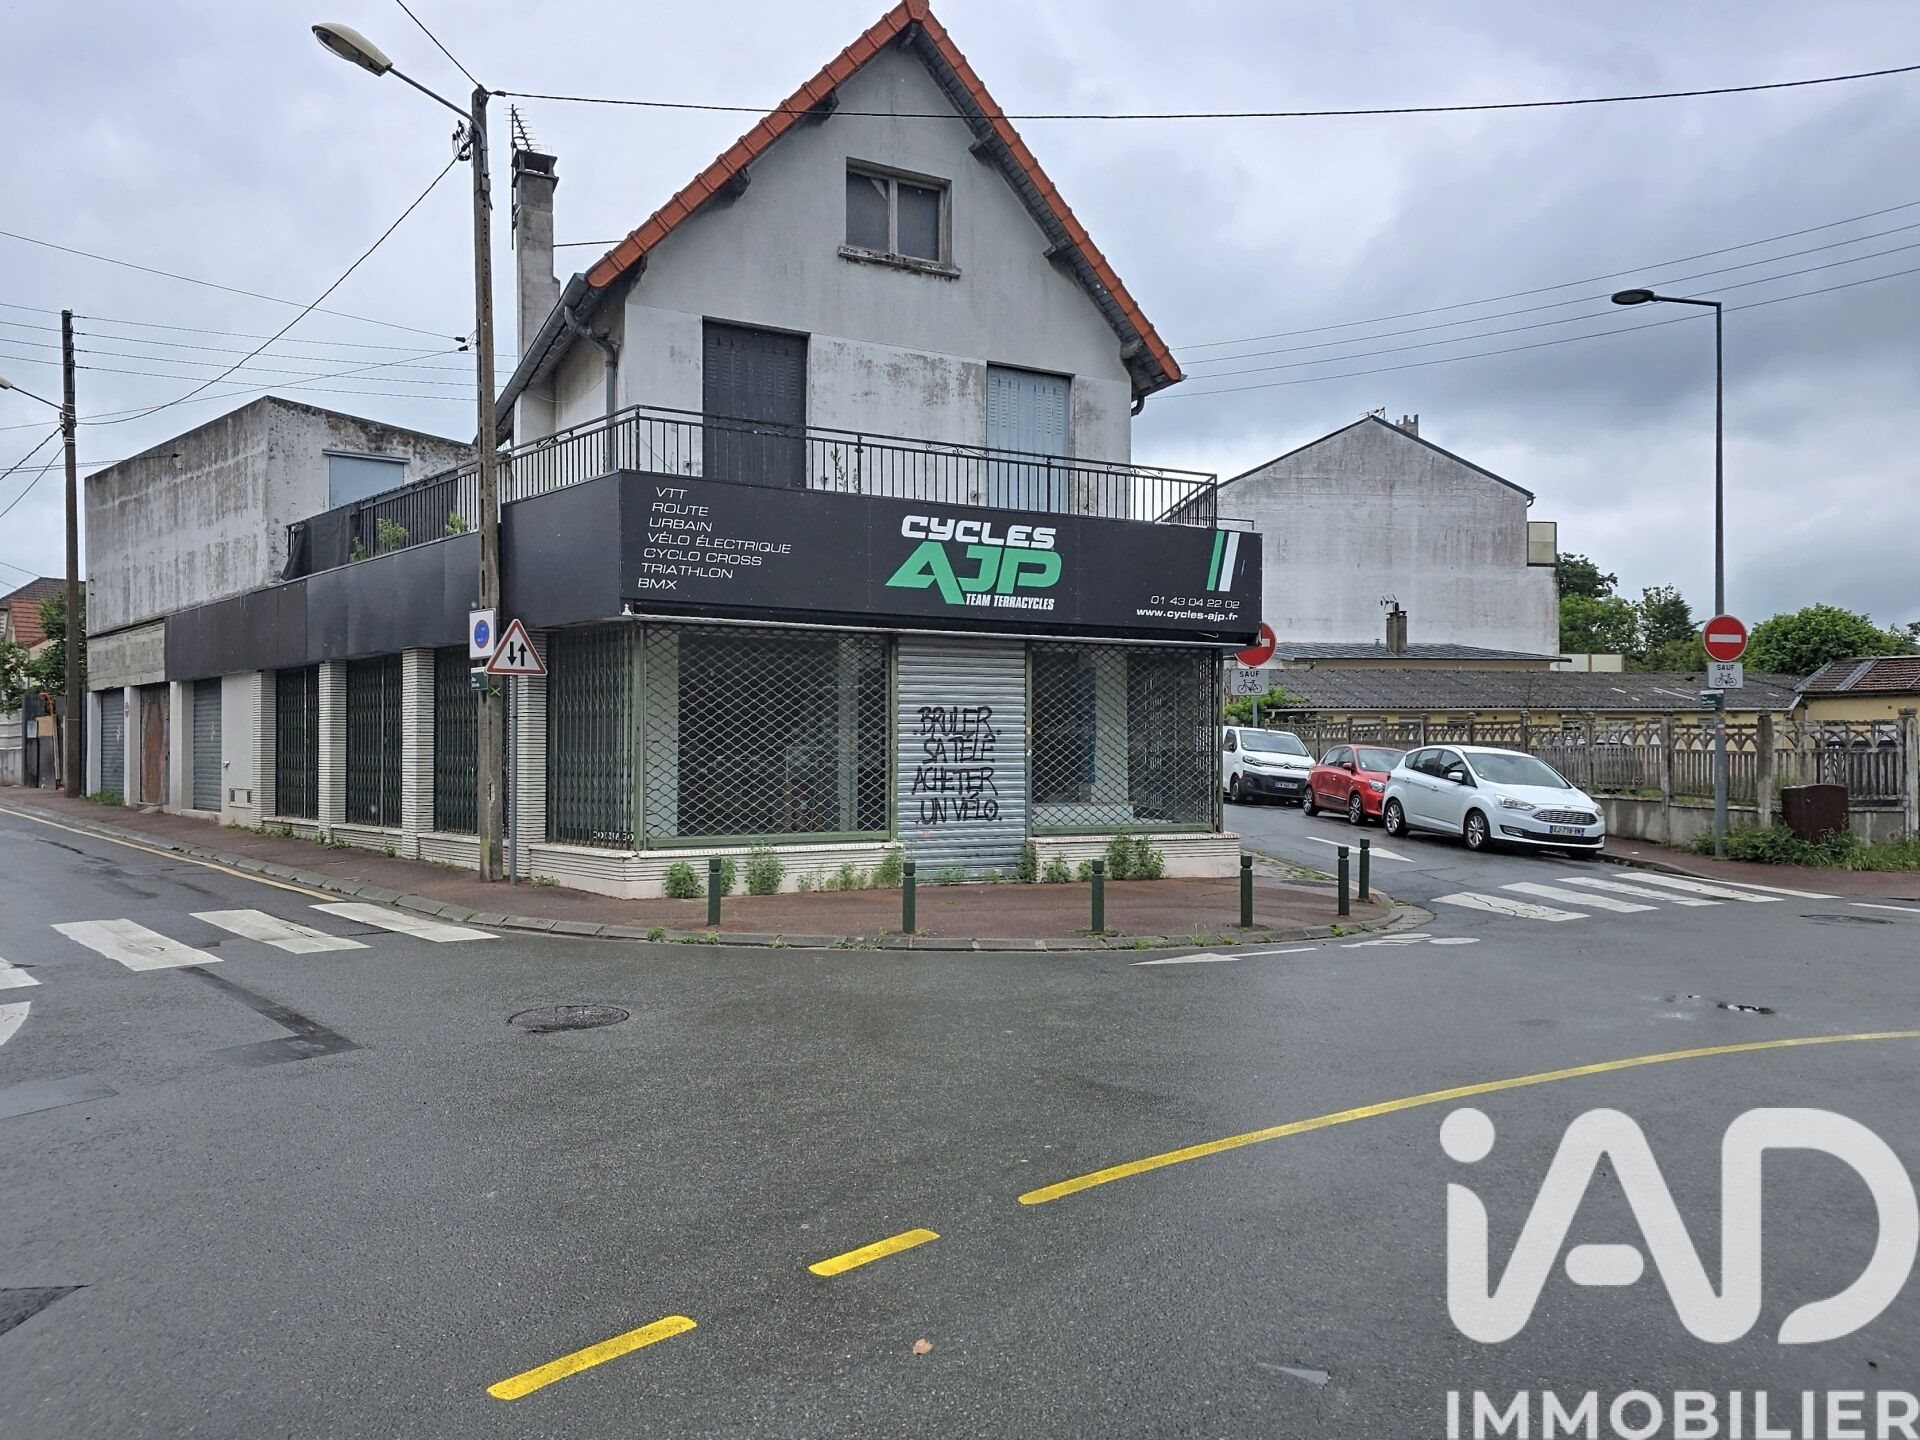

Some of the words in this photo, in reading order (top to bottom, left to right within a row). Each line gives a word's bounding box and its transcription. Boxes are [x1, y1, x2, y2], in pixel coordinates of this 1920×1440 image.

[655, 486, 688, 500] VTT
[651, 502, 709, 517] ROUTE
[649, 517, 713, 532] URBAIN
[901, 515, 1057, 549] CYCLES
[647, 531, 690, 546] VÉLO
[695, 534, 792, 554] ÉLECTRIQUE
[643, 547, 700, 562] CYCLO
[705, 552, 762, 566] CROSS
[641, 562, 734, 579] TRIATHLON
[885, 541, 1062, 604] AJP
[637, 577, 678, 590] BMX
[965, 593, 991, 606] TEAM
[993, 594, 1055, 610] TERRACYCLES
[1150, 595, 1165, 605] 01
[1169, 596, 1185, 606] 43
[1188, 598, 1203, 607] 04
[1206, 599, 1222, 609] 22
[1224, 600, 1240, 609] 02
[1136, 608, 1238, 622] www.cycles-ajp.fr
[1239, 670, 1260, 678] SAUF
[911, 765, 998, 796] ACHETER
[920, 797, 947, 825] UN
